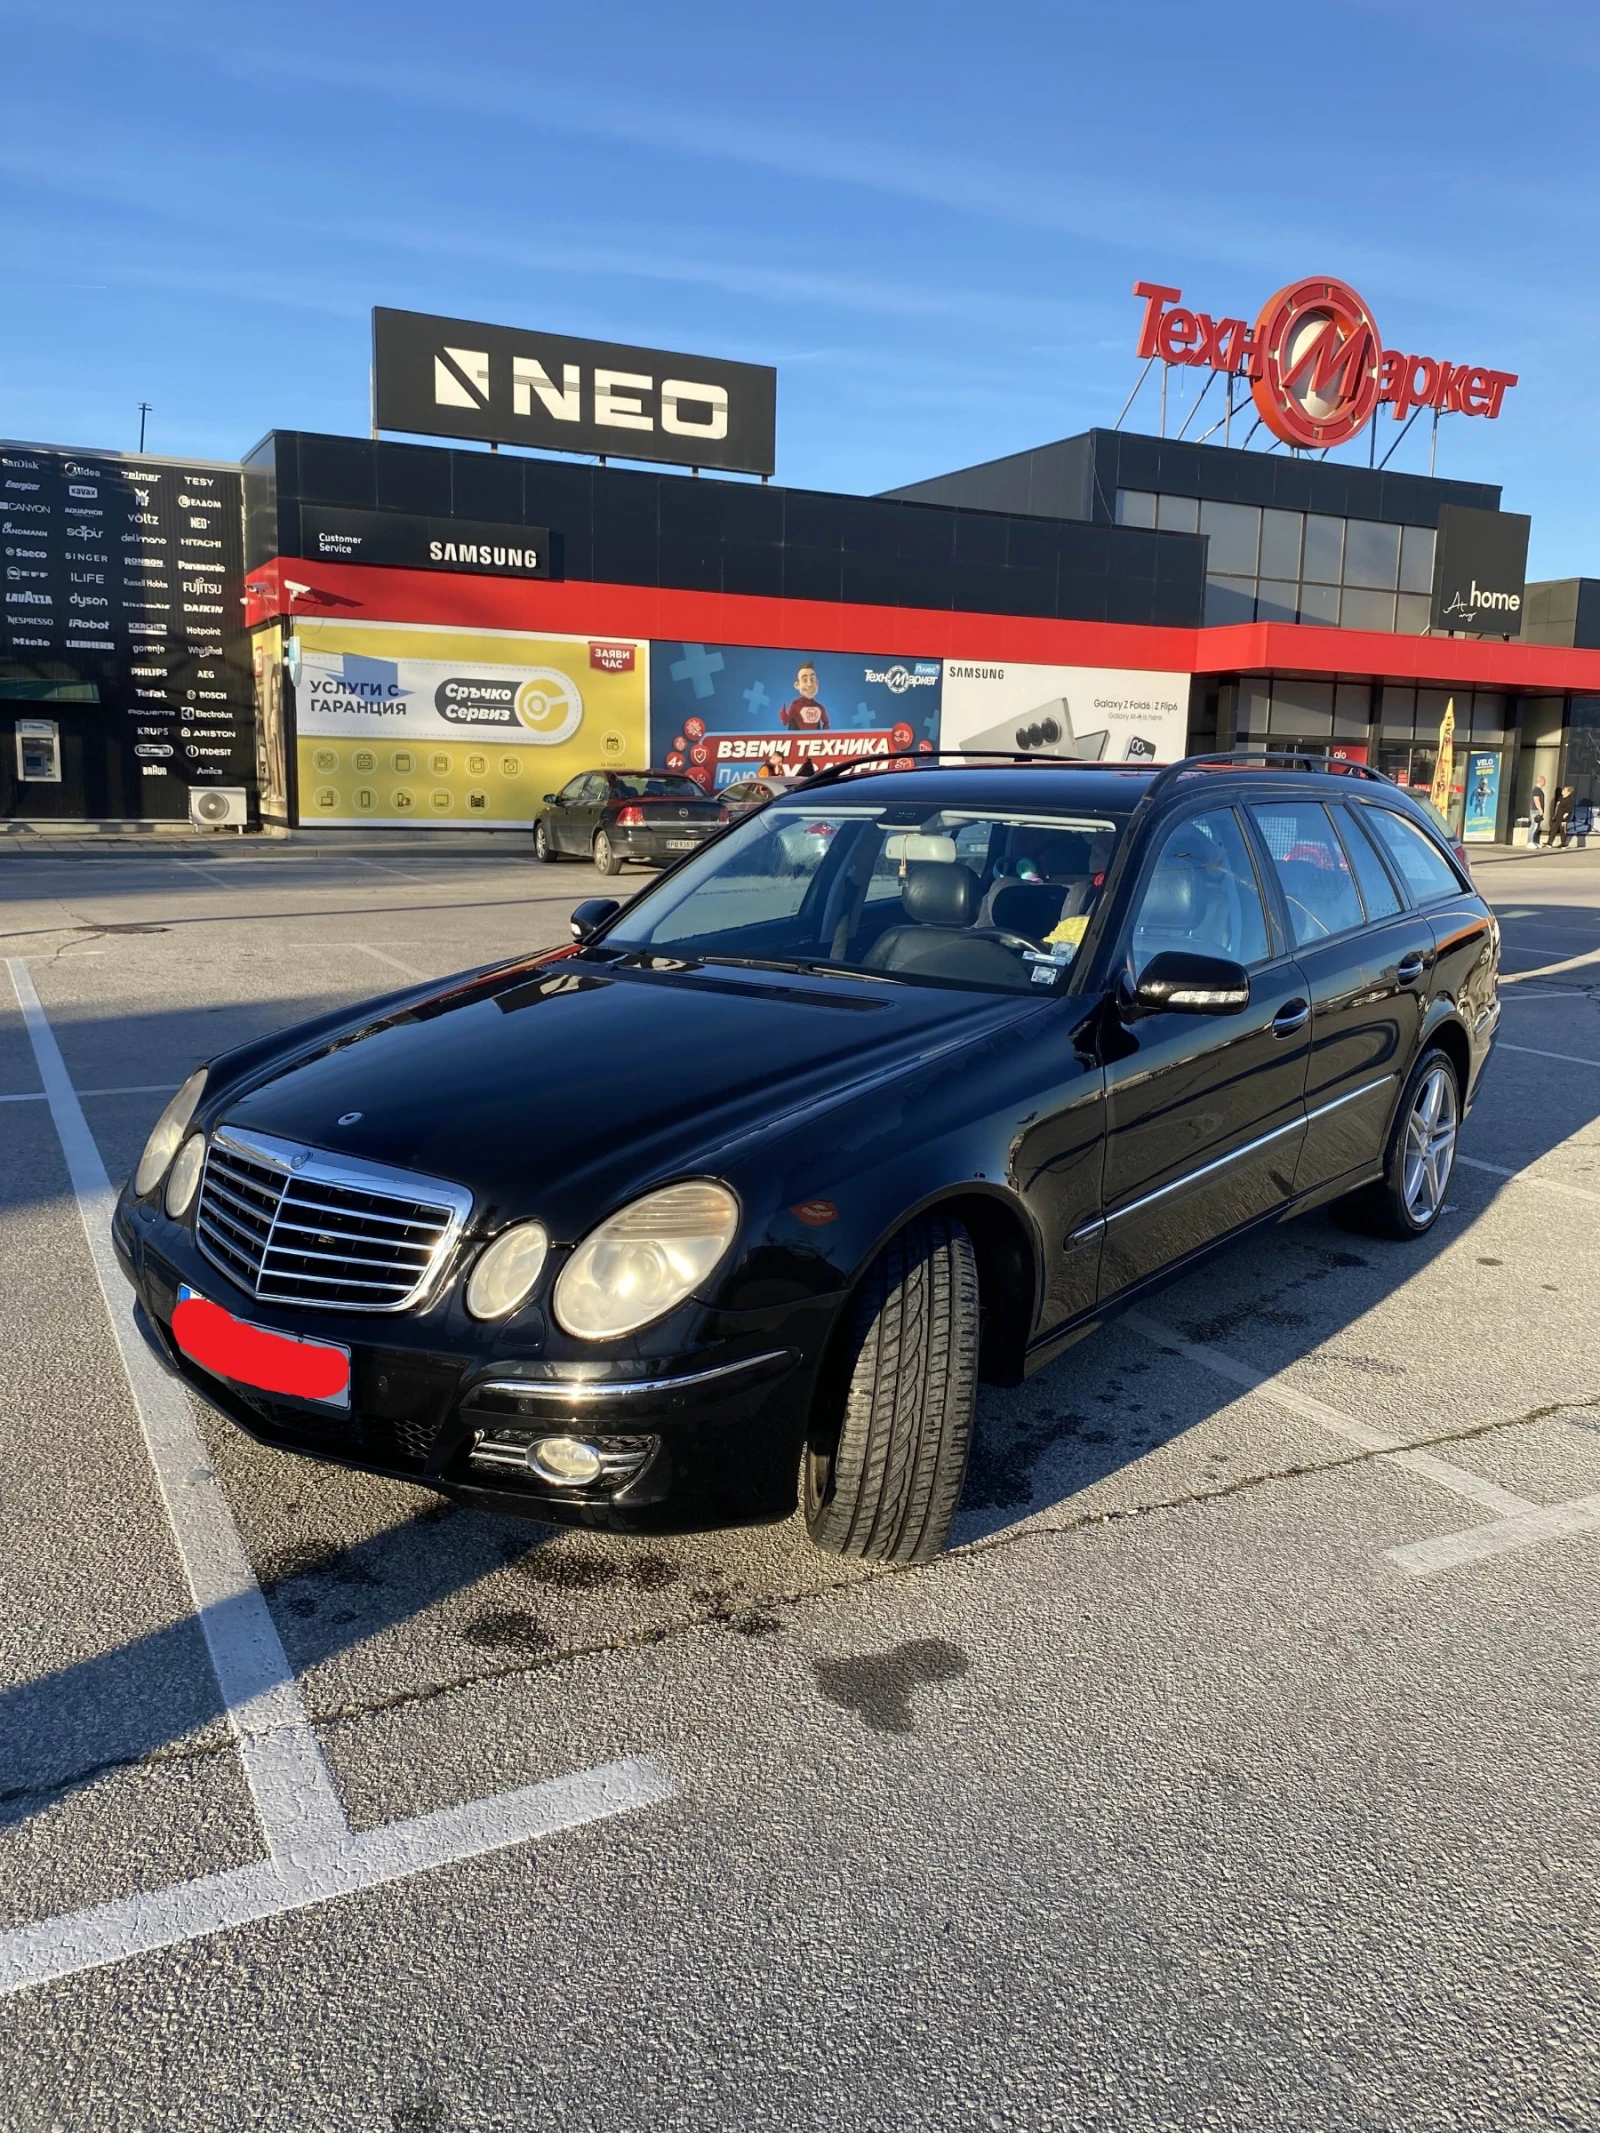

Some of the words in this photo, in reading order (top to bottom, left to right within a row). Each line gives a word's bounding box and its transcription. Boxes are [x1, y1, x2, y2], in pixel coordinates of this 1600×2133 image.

[513, 356, 728, 440] NEO
[2, 458, 39, 470] SanDisk
[66, 463, 100, 477] Midea
[121, 471, 161, 482] zelmer
[184, 476, 214, 487] TESY
[5, 480, 40, 491] Energizer
[71, 488, 96, 496] xavax
[9, 503, 50, 513] CANYON
[65, 507, 103, 516] AQUAPHOR
[2, 528, 47, 537] LANDMANN
[121, 533, 167, 545] delimano
[181, 539, 221, 548] HITACHI
[319, 533, 362, 544] Customer
[319, 542, 352, 553] Service
[16, 548, 47, 558] Saeco
[65, 553, 108, 562] SINGER
[429, 541, 537, 568] SAMSUNG
[124, 557, 164, 567] RONSON
[178, 560, 225, 573] Panasonic
[71, 572, 104, 584] ILIFE
[124, 578, 145, 587] Russell
[147, 579, 168, 588] Hobbs
[183, 582, 222, 595] FUJITSU
[6, 591, 53, 605] LAVAZZA
[69, 593, 108, 607] dyson
[1443, 591, 1467, 613] At
[1470, 580, 1520, 611] home
[184, 604, 224, 614] DAIKIN
[69, 619, 110, 629] iRobot
[186, 626, 221, 636] Hotpoint
[12, 637, 51, 646] Miele
[66, 640, 115, 650] LIEBHERR
[133, 644, 165, 654] gorenje
[188, 645, 223, 658] Whirlpool
[595, 649, 630, 659] ЗАЯВИ
[601, 659, 623, 668] ЧАС
[131, 668, 168, 677] PHILIPS
[197, 670, 215, 678] AEG
[949, 666, 1005, 680] SAMSUNG
[135, 689, 168, 698] Tefal
[310, 681, 382, 696] УСЛУГИ
[387, 684, 399, 697] С
[445, 683, 512, 700] Сръчко
[199, 691, 227, 699] BOSCH
[310, 699, 406, 717] ГАРАНЦИЯ
[1093, 699, 1123, 711] Galaxy
[1124, 701, 1129, 709] Z
[1130, 701, 1151, 710] Fold6
[1154, 702, 1160, 710] Z
[1161, 702, 1178, 713] Flip6
[195, 710, 233, 719] Electrolux
[445, 704, 510, 722] Сервиз
[1108, 712, 1129, 721] Galaxy
[137, 727, 169, 735] KRUPS
[193, 730, 236, 738] ARISTON
[717, 739, 791, 758] ВЗЕМИ
[797, 737, 890, 757] ТЕХНИКА
[1477, 759, 1493, 767] VELO
[196, 767, 223, 775] Amica
